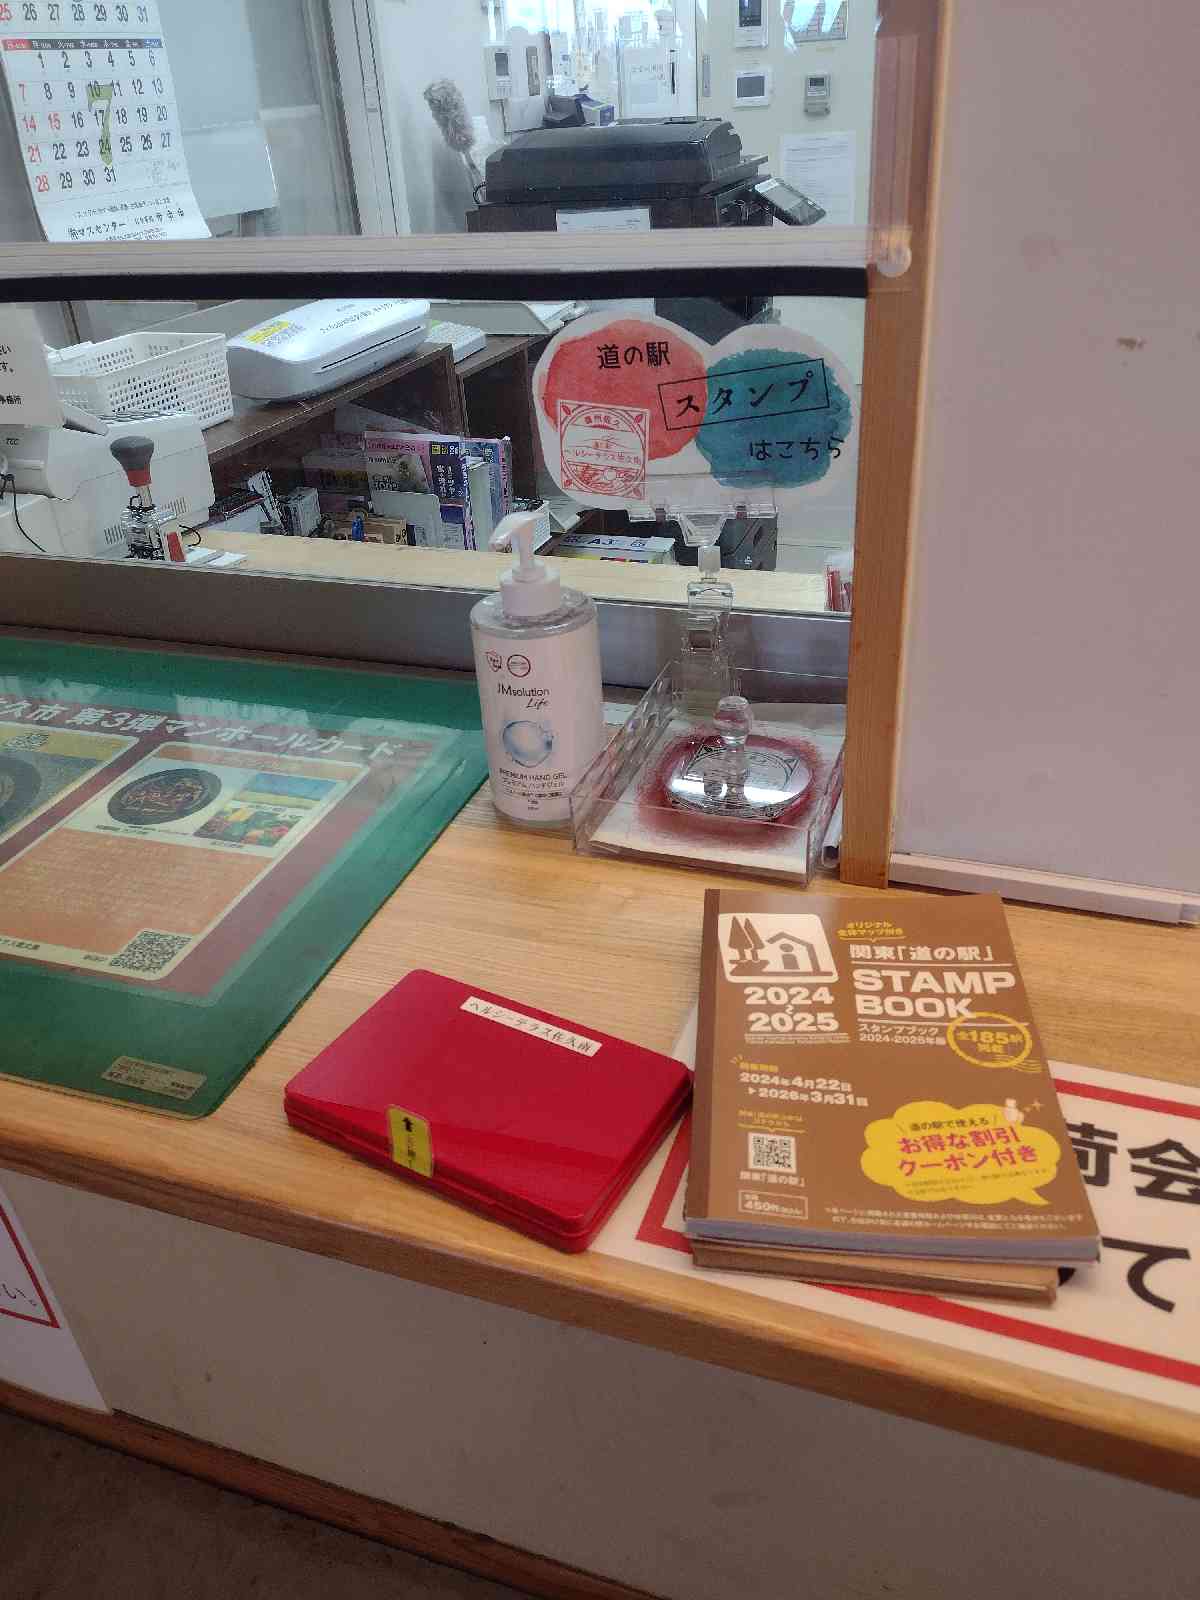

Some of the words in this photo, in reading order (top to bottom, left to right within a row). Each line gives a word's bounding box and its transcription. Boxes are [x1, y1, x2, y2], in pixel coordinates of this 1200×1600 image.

[23, 3, 38, 21] 26
[48, 3, 60, 21] 27
[72, 3, 85, 22] 28
[95, 4, 108, 22] 29
[116, 5, 129, 22] 30
[137, 6, 149, 23] 31
[37, 53, 45, 68] 1
[62, 51, 71, 68] 2
[85, 51, 93, 68] 3
[107, 51, 115, 67] 4
[128, 50, 136, 66] 5
[44, 83, 52, 100] 8
[68, 82, 76, 98] 9
[89, 81, 101, 97] 10
[112, 80, 123, 96] 11
[132, 79, 144, 95] 12
[152, 78, 164, 94] 13
[23, 115, 37, 132] 14
[48, 113, 61, 130] 15
[72, 112, 84, 128] 16
[94, 110, 105, 127] 17
[115, 109, 127, 125] 18
[137, 107, 148, 123] 19
[157, 106, 168, 121] 20
[53, 143, 67, 160] 22
[76, 141, 89, 157] 23
[99, 139, 111, 154] 24
[120, 137, 132, 152] 25
[141, 135, 152, 151] 26
[161, 133, 171, 148] 27
[35, 175, 50, 192] 28
[60, 173, 73, 189] 29
[83, 170, 96, 186] 30
[104, 167, 117, 183] 31
[597, 341, 671, 369] 道の駅
[676, 369, 815, 417] スタンプ
[750, 437, 845, 461] はこちら
[498, 683, 550, 697] JMsolution
[526, 697, 550, 710] Life
[850, 943, 994, 962] 関東「道の駅」
[853, 968, 1016, 995] STAMP
[743, 986, 835, 1005] 2024
[855, 994, 977, 1019] BOOK
[748, 1012, 840, 1032] 2025
[739, 1072, 852, 1093] 2024年4月22日
[900, 1145, 1039, 1176] クーポン付き
